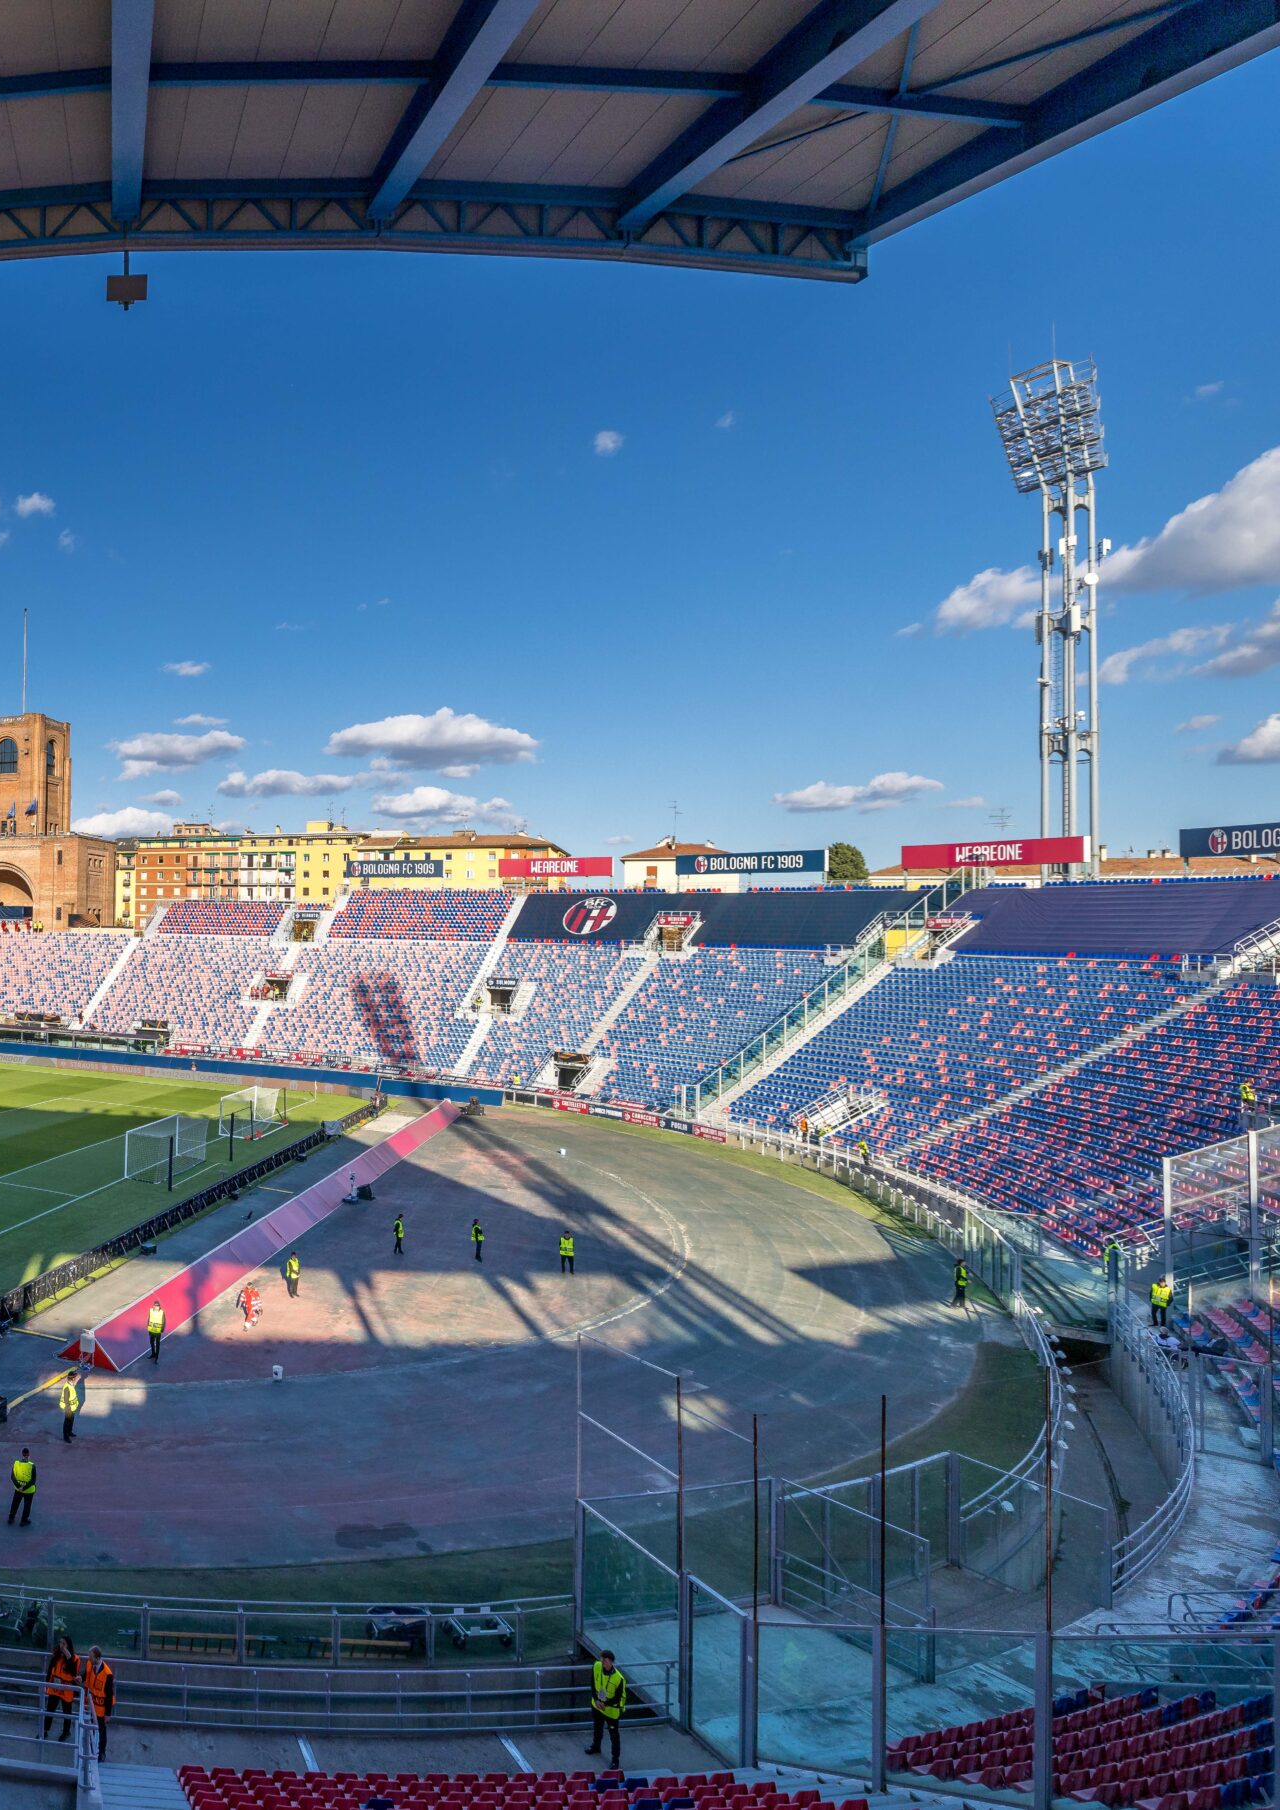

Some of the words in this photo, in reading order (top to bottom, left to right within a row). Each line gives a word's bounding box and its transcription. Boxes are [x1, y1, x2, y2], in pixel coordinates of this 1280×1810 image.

[955, 844, 1022, 862] WEAREONE
[362, 864, 400, 875] BOLOGNA
[402, 863, 413, 874] FC
[414, 862, 434, 874] 1909
[530, 861, 578, 873] WEAREONE
[710, 857, 758, 870] BOLOGNA
[761, 856, 774, 869] FC
[776, 855, 803, 868] 1909
